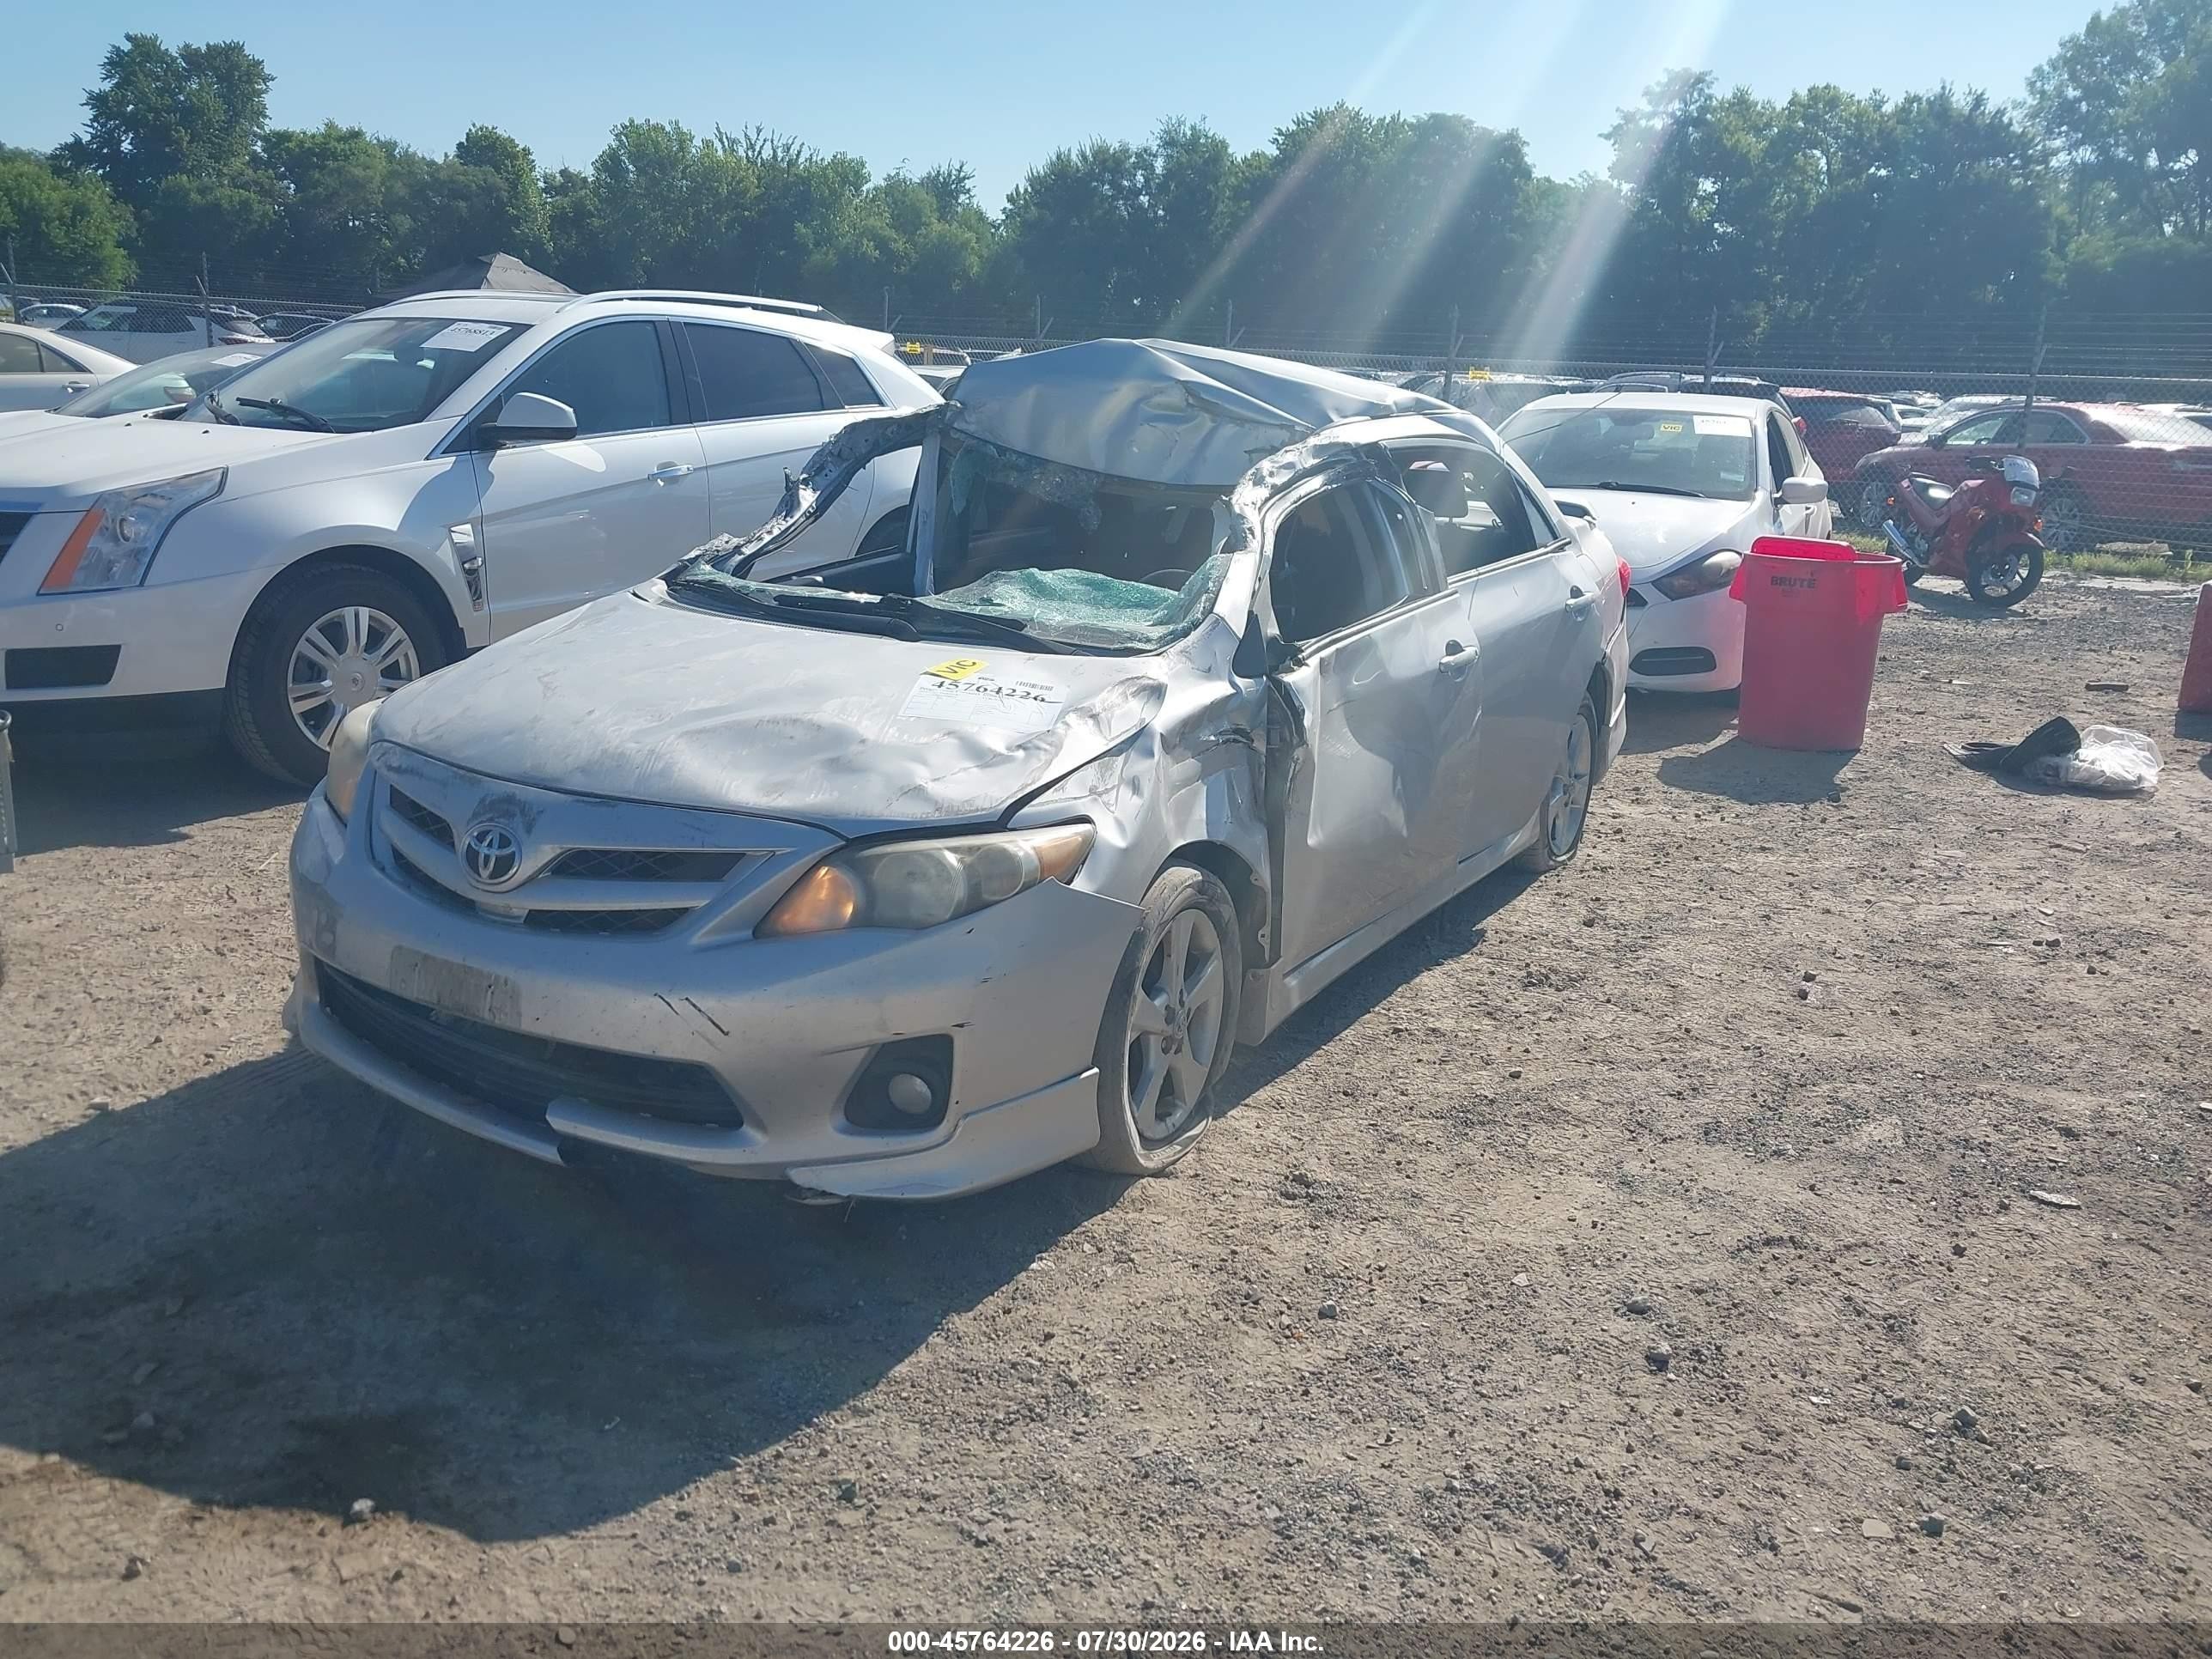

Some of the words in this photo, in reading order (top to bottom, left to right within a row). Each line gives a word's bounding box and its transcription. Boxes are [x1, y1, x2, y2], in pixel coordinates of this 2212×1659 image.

[1771, 576, 1816, 589] BRUTE
[936, 659, 977, 675] VIC
[931, 680, 1046, 703] 45764226
